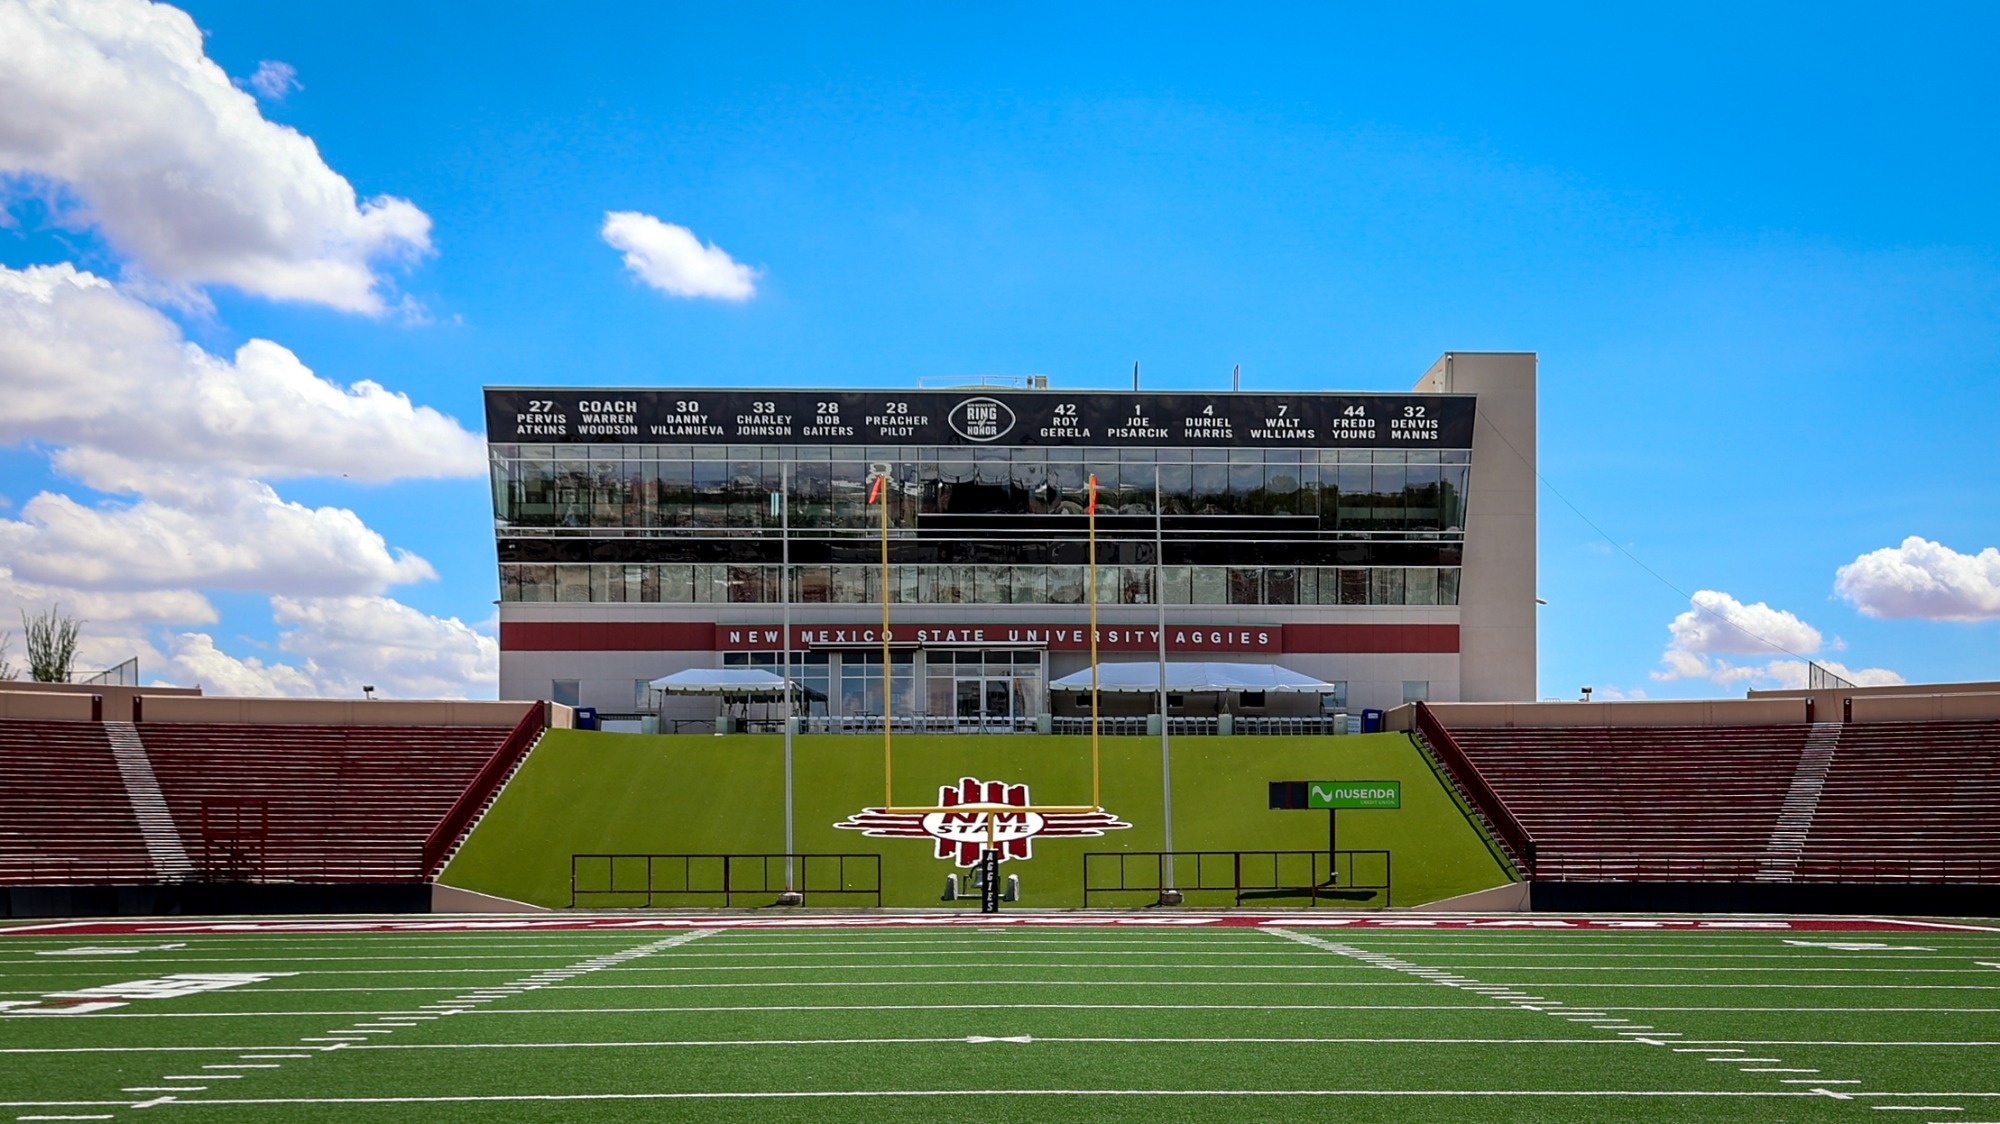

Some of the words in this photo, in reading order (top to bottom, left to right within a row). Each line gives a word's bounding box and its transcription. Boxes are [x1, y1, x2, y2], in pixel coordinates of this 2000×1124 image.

[529, 400, 553, 413] 27
[579, 400, 637, 413] COACH
[676, 400, 699, 413] 30
[753, 401, 776, 414] 33
[817, 402, 839, 414] 28
[886, 402, 908, 414] 28
[1054, 403, 1076, 416] 42
[1135, 404, 1141, 416] 1
[1202, 404, 1214, 416] 4
[1277, 405, 1288, 417] 7
[1343, 405, 1366, 417] 44
[1403, 406, 1426, 418] 32
[517, 413, 567, 424] PERVIS
[582, 414, 634, 424] WARREN
[666, 414, 708, 424] DANNY
[967, 407, 997, 420] RING
[736, 414, 792, 425] CHARLEY
[816, 415, 840, 425] BOB
[865, 415, 928, 426] PREACHER
[1052, 416, 1079, 426] ROY
[1126, 417, 1149, 427] JOE
[1185, 417, 1232, 428] DURIEL
[1265, 418, 1300, 428] WALT
[1333, 418, 1375, 428] FREDD
[1391, 419, 1439, 429] DENVIS
[516, 424, 567, 435] ATKINS
[577, 425, 638, 435] WOODSON
[650, 425, 724, 435] VILLANUEVA
[736, 426, 792, 436] JOHNSON
[803, 426, 854, 436] GAITERS
[880, 426, 914, 436] PILOT
[967, 425, 997, 436] HONOR
[1040, 427, 1091, 437] GERELA
[1107, 428, 1169, 438] PISARCIK
[1184, 428, 1233, 439] HARRIS
[1250, 429, 1315, 439] WILLIAMS
[1332, 429, 1376, 439] YOUNG
[1391, 430, 1438, 440] MANNS
[730, 630, 779, 643] NEW
[801, 630, 894, 643] MEXICO
[917, 629, 984, 642] STATE
[1008, 629, 1160, 643] UNIVERSITY
[1175, 631, 1269, 644] AGGIES
[1335, 788, 1395, 799] NUSENDA
[937, 824, 1030, 834] STATE
[986, 852, 994, 912] AGGIES
